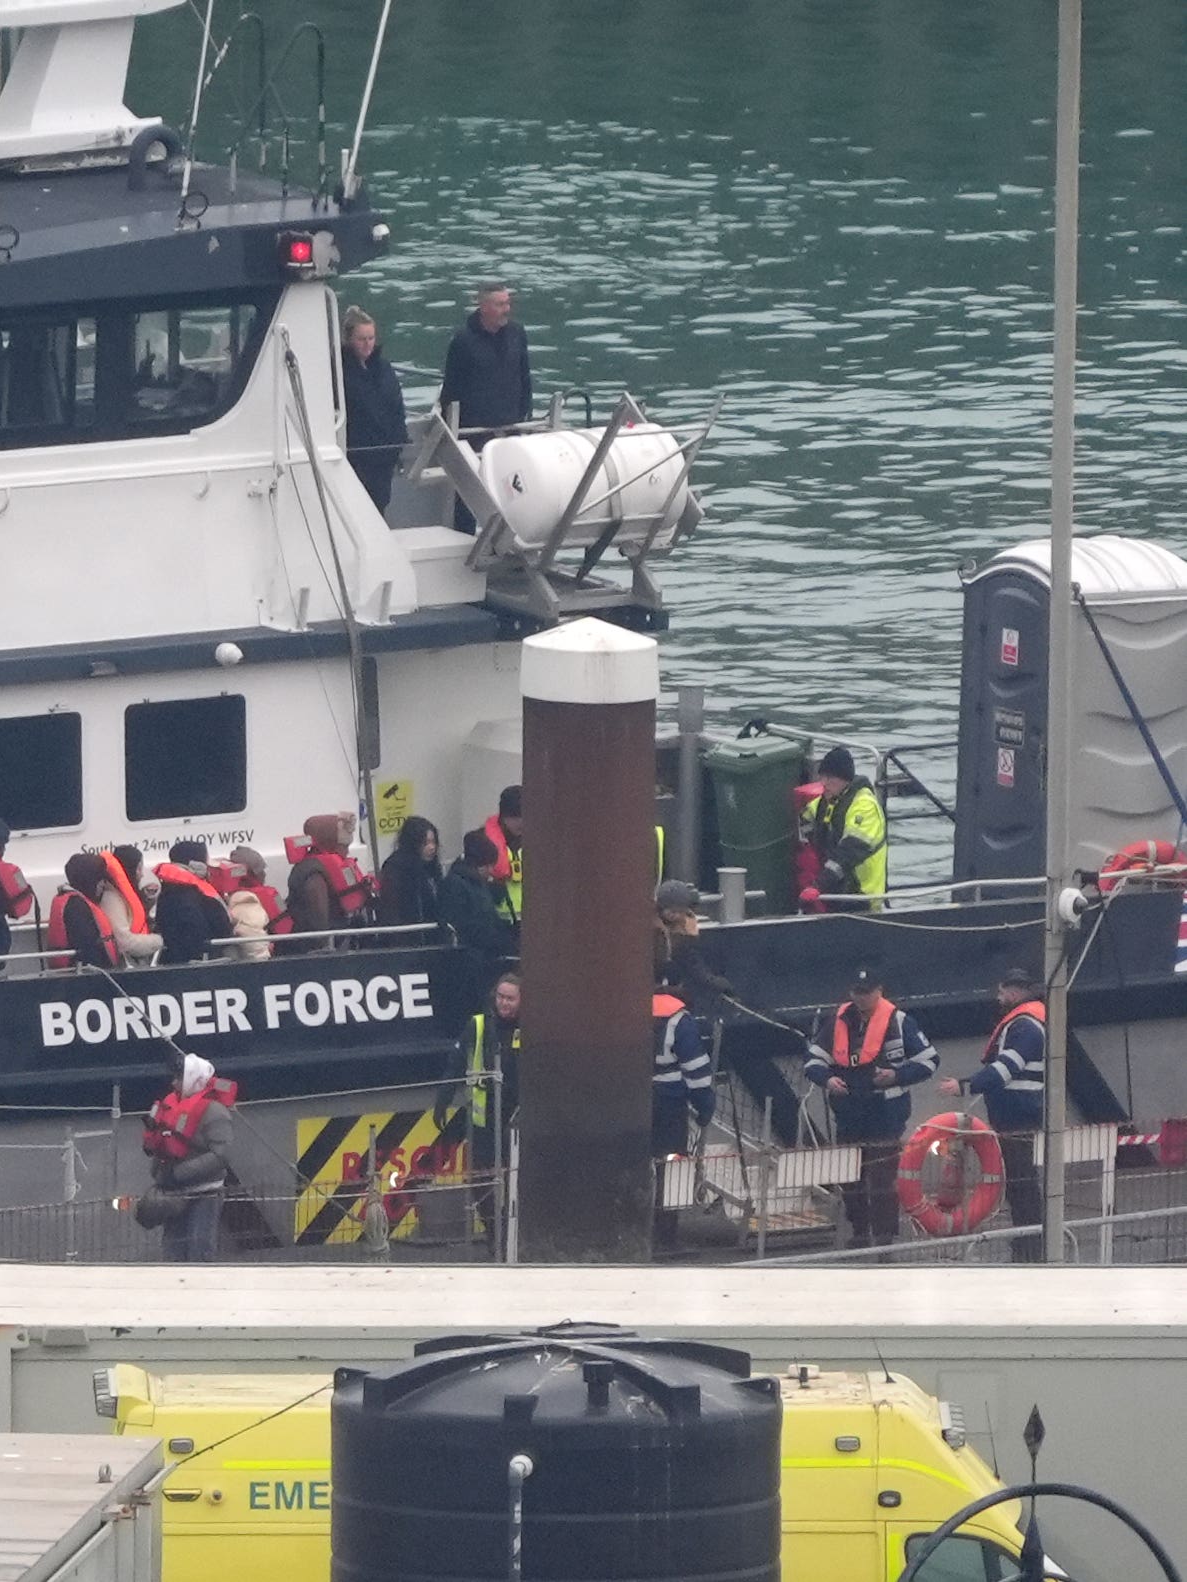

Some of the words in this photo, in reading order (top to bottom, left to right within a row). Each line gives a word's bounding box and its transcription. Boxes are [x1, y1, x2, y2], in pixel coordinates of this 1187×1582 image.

[143, 837, 169, 852] 24m
[218, 829, 254, 844] WFSV
[39, 987, 252, 1047] BORDER
[263, 972, 434, 1029] FORCE
[249, 1481, 331, 1510] EME
